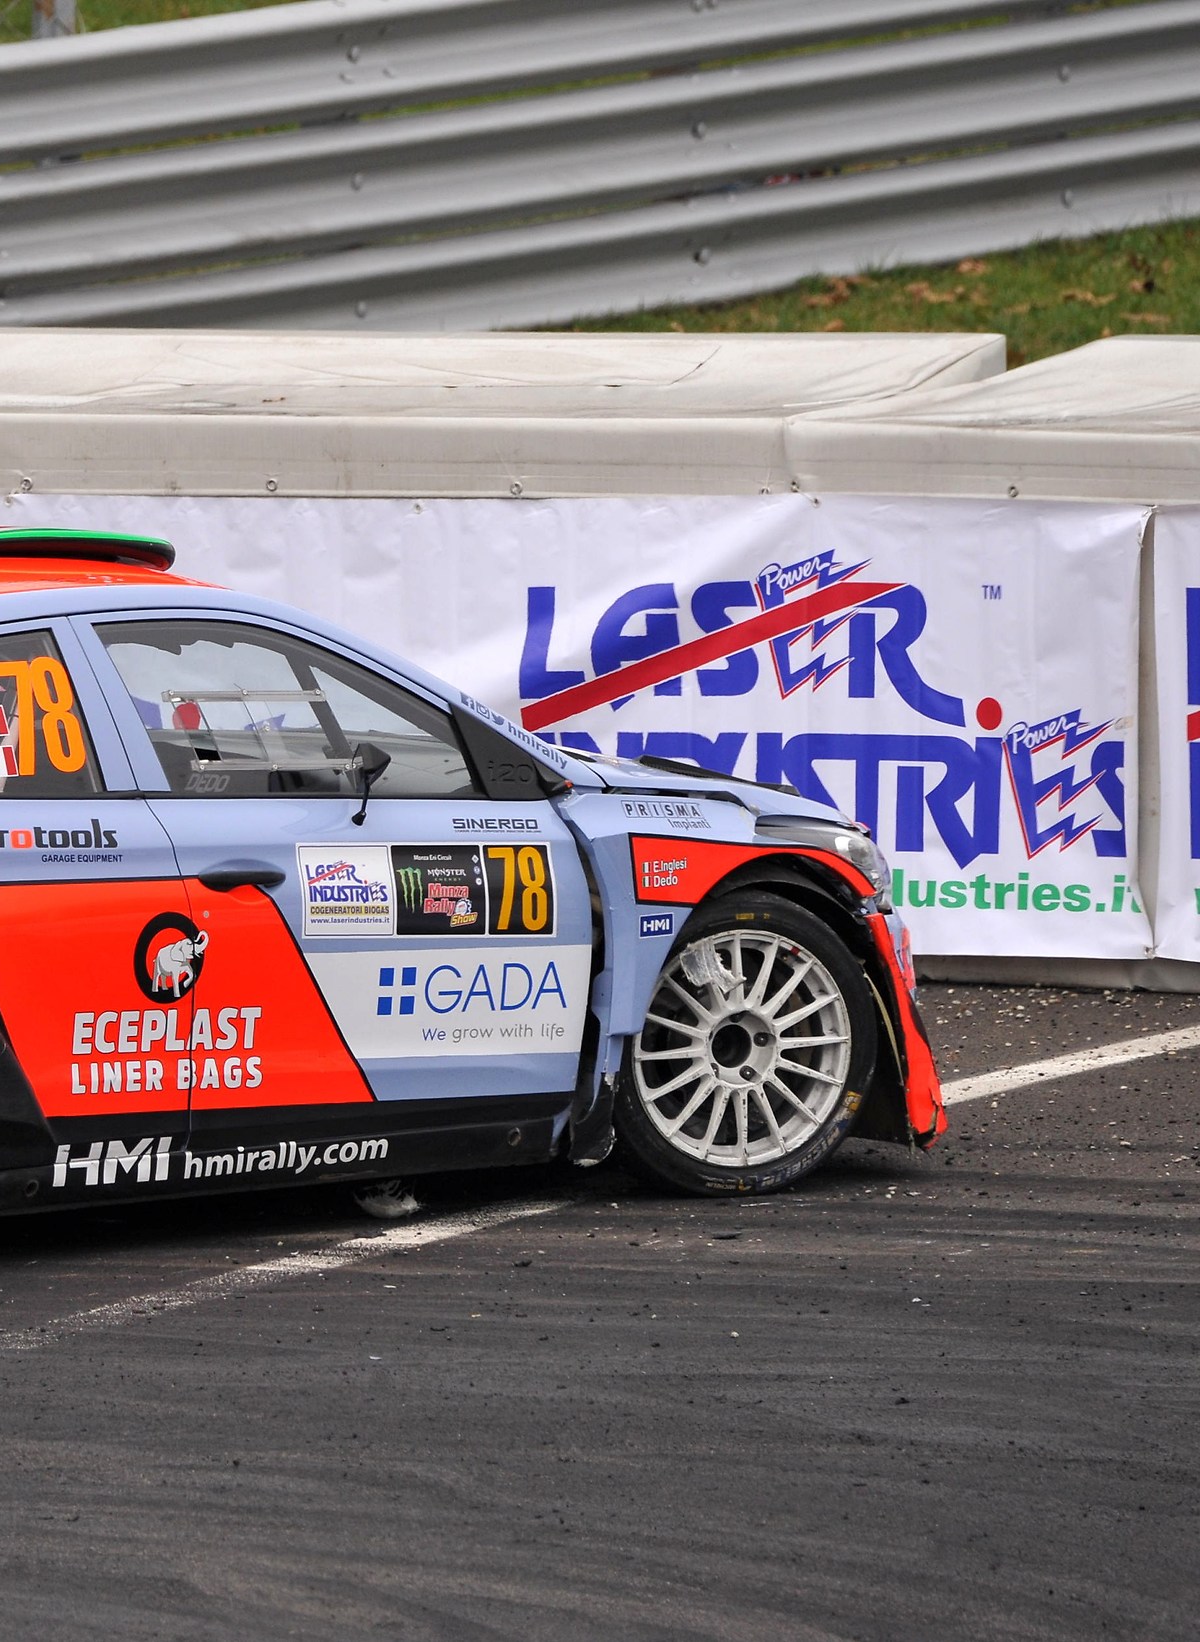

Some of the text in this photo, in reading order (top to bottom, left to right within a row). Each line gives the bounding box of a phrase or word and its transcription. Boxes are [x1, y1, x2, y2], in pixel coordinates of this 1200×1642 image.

[760, 557, 830, 595] Power
[982, 585, 1001, 600] TM
[519, 580, 965, 728] LASER
[1006, 716, 1078, 754] Power
[508, 721, 568, 769] hmirally
[625, 803, 701, 817] PRISMA
[452, 818, 538, 829] SINERGO
[668, 818, 711, 831] Impianti
[41, 854, 123, 863] GARAGE EQUIPMENT
[653, 858, 687, 874] E.Inglesi
[427, 867, 466, 877] MONSTER
[487, 846, 548, 931] 78
[653, 875, 678, 887] Dedo
[310, 905, 389, 914] COGENERATORI BIOGAS
[424, 897, 456, 916] Rally
[451, 913, 478, 926] Show
[642, 918, 670, 933] HMI
[424, 961, 567, 1014] GADA
[72, 1007, 262, 1056] ECEPLAST
[422, 1022, 565, 1043] We grow with life
[71, 1056, 263, 1094] LINER BAGS
[53, 1137, 389, 1187] HMI hmirally.com
